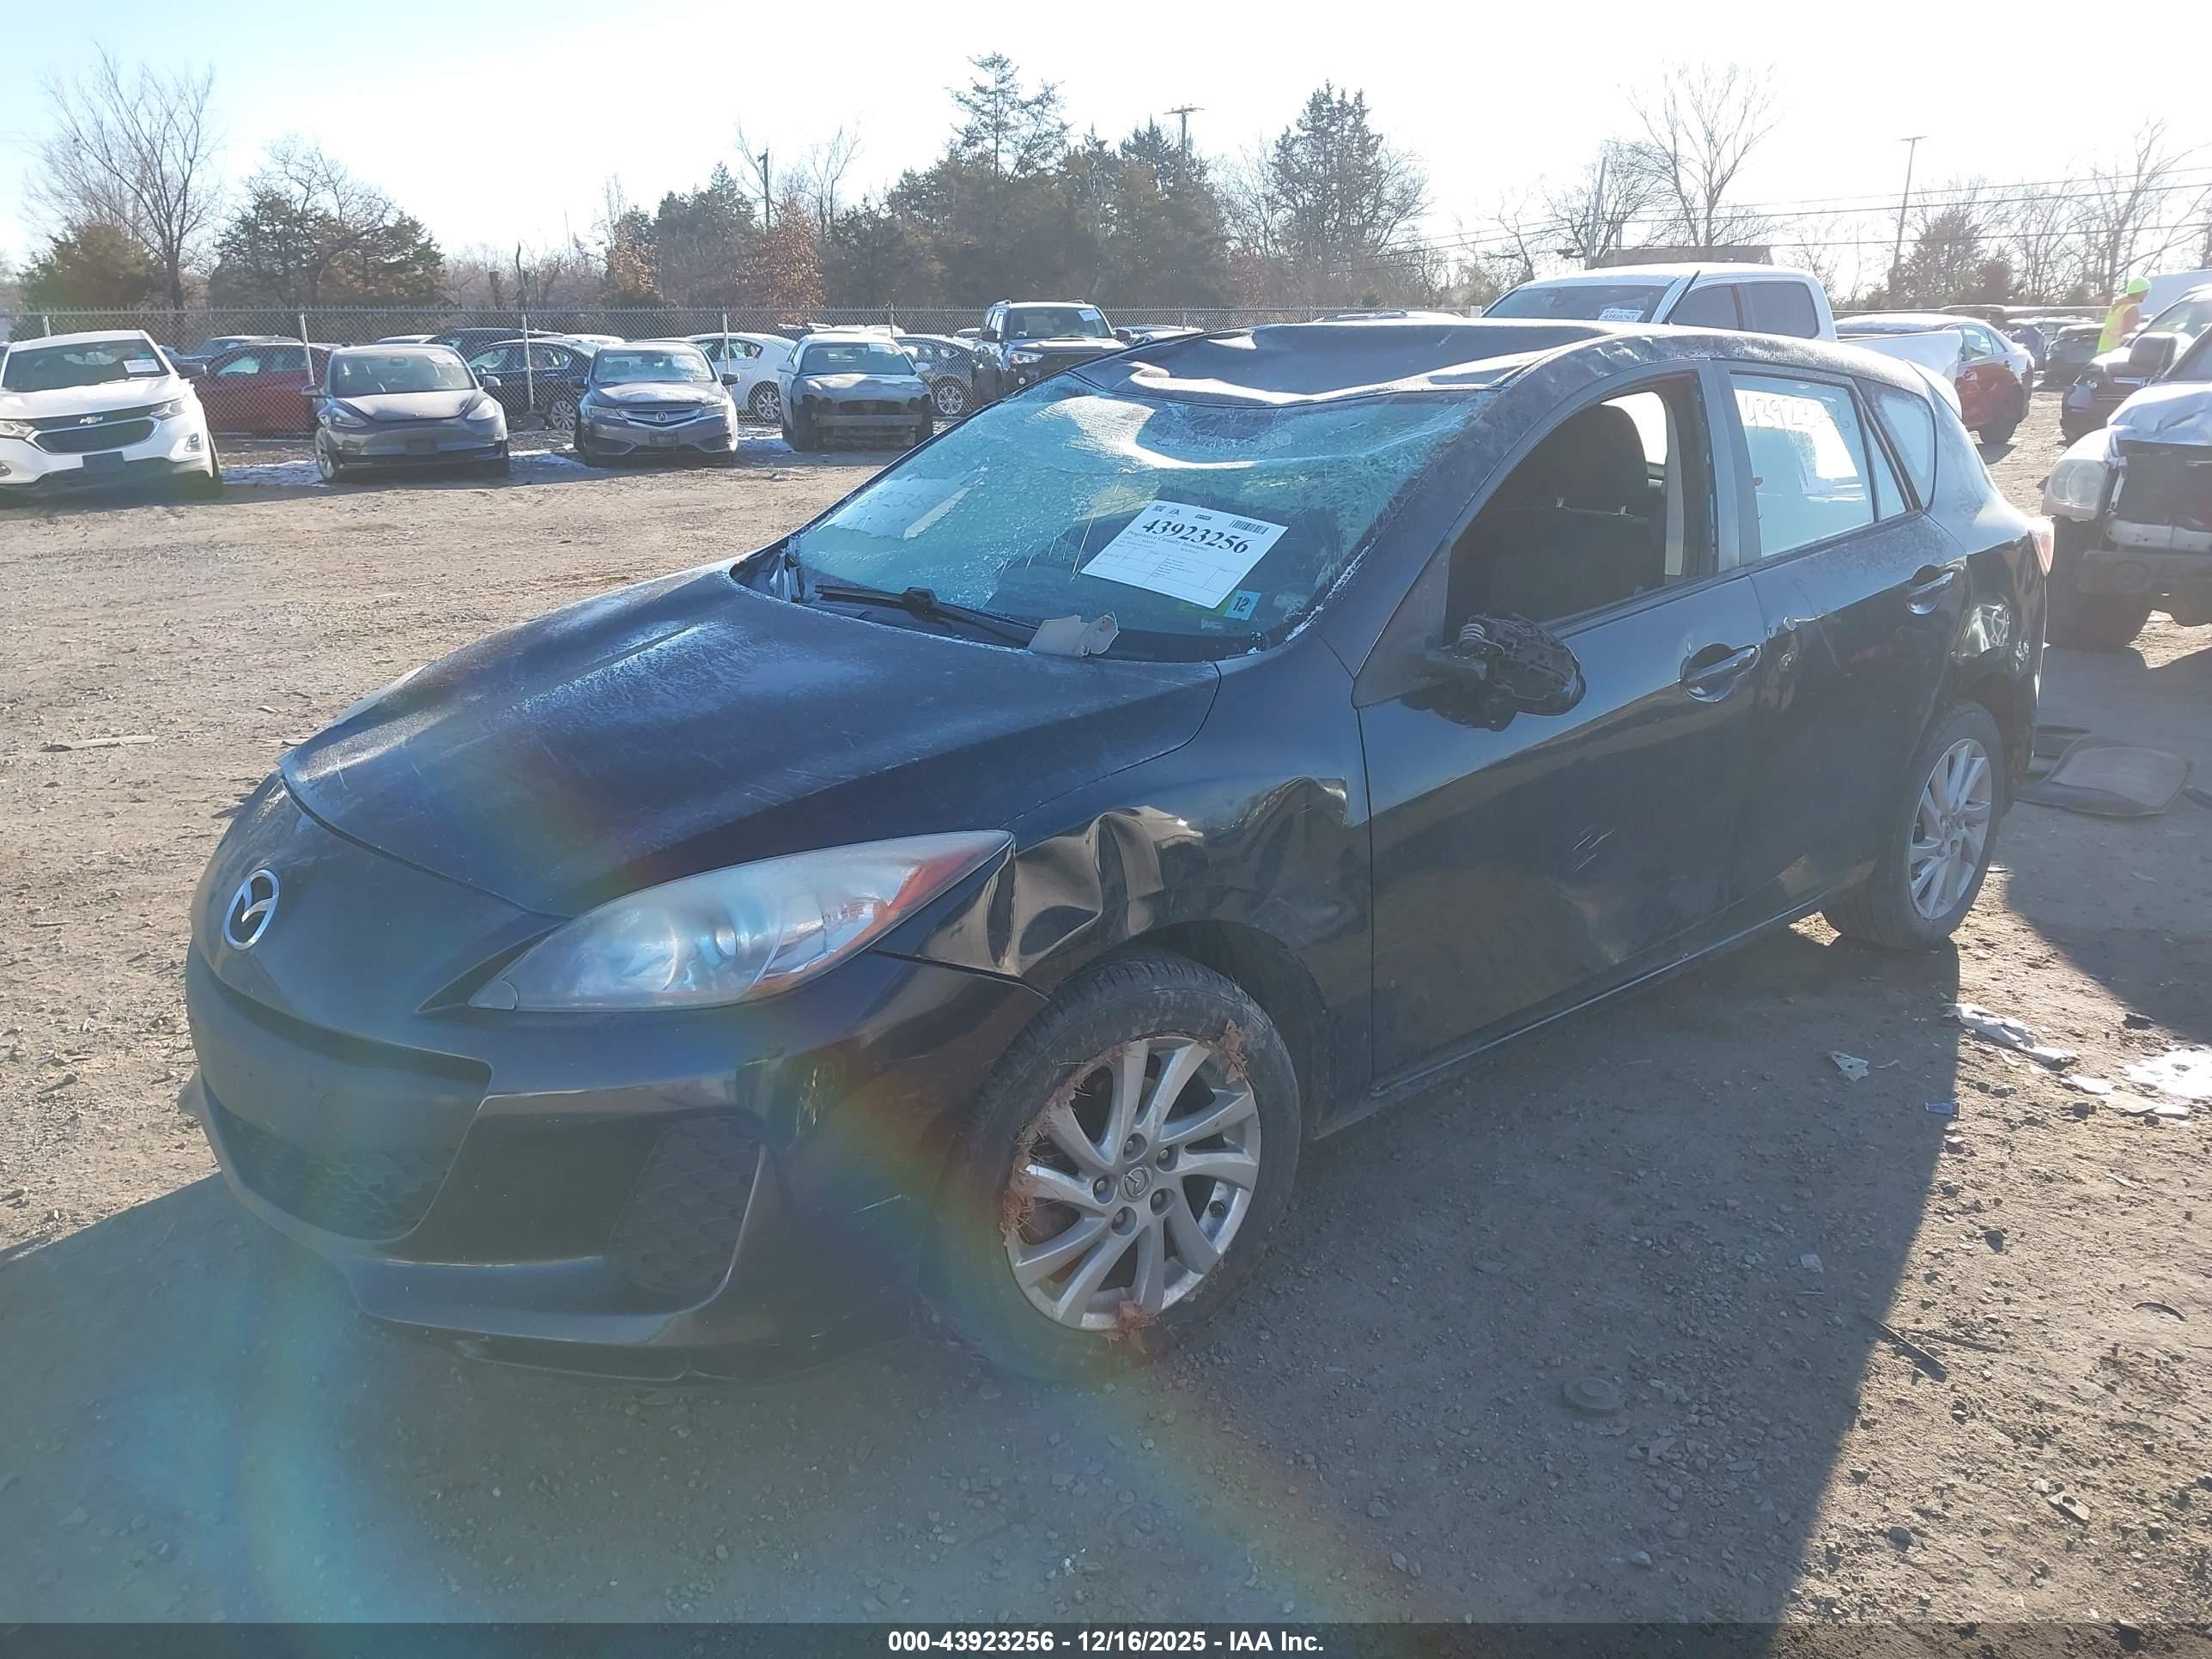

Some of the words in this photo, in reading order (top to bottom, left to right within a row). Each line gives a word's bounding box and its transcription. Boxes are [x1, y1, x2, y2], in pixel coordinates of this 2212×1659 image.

[1141, 519, 1256, 554] 43923256
[1182, 541, 1209, 552] Insurance
[1232, 597, 1250, 612] 12
